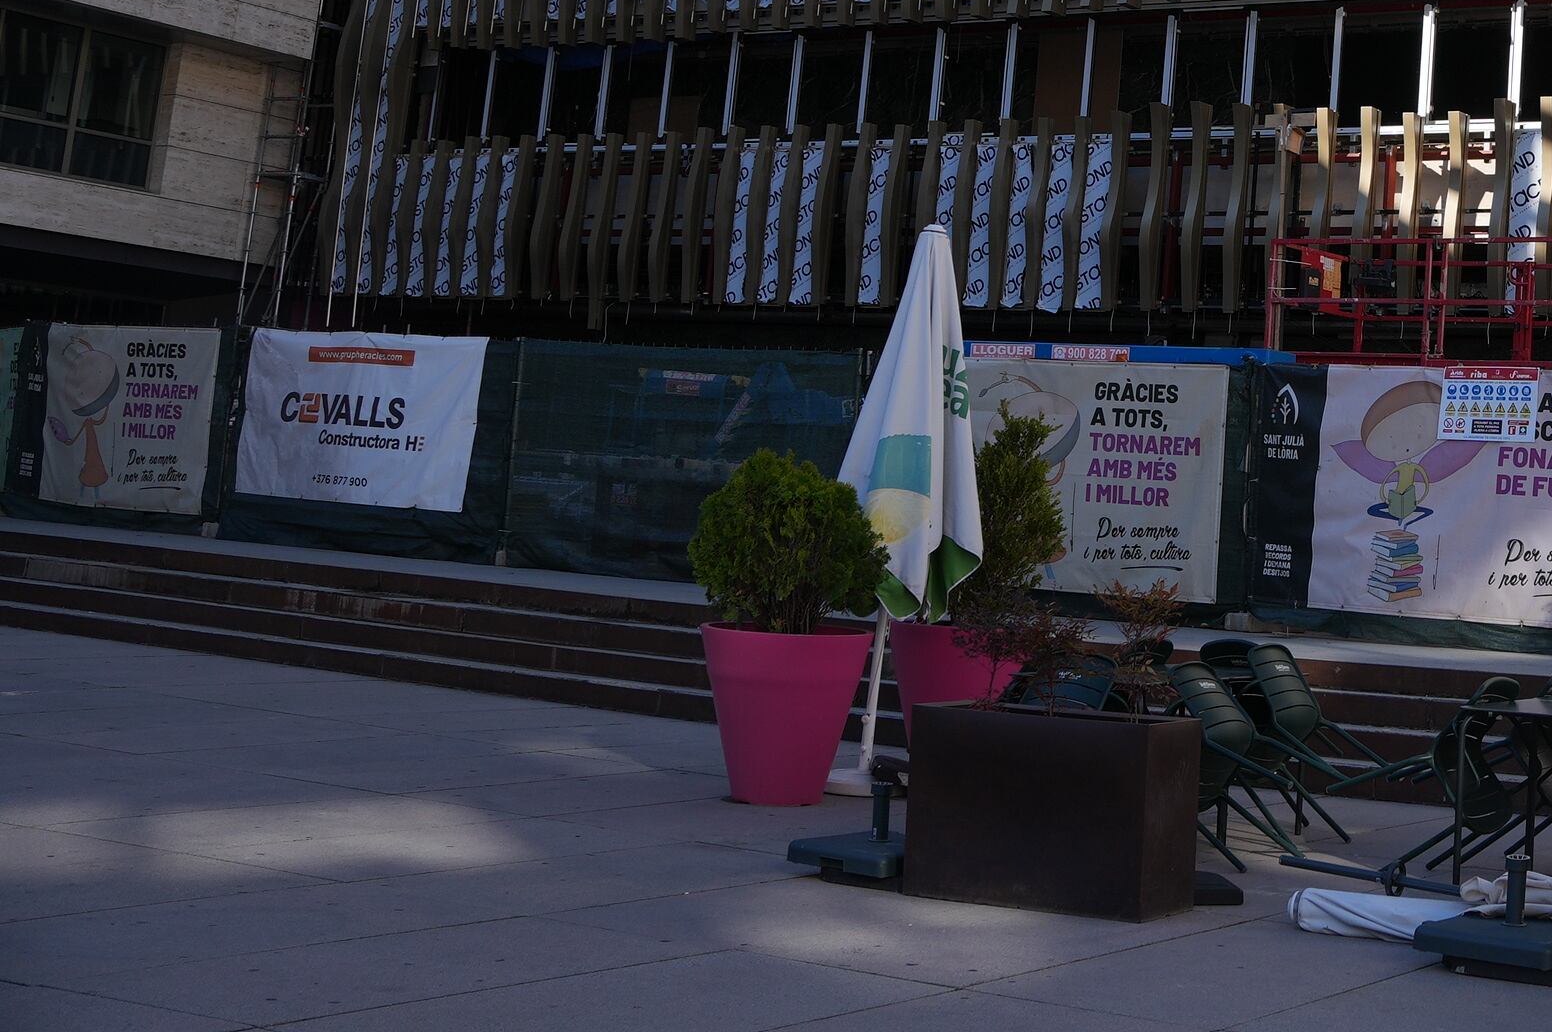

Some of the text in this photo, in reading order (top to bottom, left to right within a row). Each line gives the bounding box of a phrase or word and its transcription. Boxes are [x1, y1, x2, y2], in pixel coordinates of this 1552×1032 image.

[127, 340, 186, 358] GRÀCIES
[973, 345, 1032, 355] LLOGUER
[1068, 348, 1085, 358] 900
[1089, 348, 1106, 359] 828
[126, 363, 178, 380] A TOTS,
[1470, 369, 1488, 378] riba
[126, 383, 198, 400] TORNAREM
[1095, 379, 1179, 403] GRÀCIES
[123, 401, 183, 420] AMB MÉS
[1090, 408, 1168, 431] A TOTS,
[128, 424, 176, 440] MILLOR
[319, 430, 399, 449] Constructora
[1263, 433, 1305, 447] SANT JULIÀ
[1090, 433, 1200, 456] TORNAREM
[1267, 446, 1299, 460] DE LÒRIA
[1086, 457, 1177, 481] AMB MÉS
[312, 474, 368, 487] +376 877 900
[1495, 474, 1527, 497] DE
[1085, 484, 1170, 506] I MILLOR
[1131, 525, 1180, 541] sempre
[1092, 547, 1117, 562] per
[1150, 541, 1192, 561] cultura
[1265, 543, 1292, 552] REPASSA
[1505, 539, 1542, 567] Per
[1488, 571, 1495, 585] i
[1499, 573, 1528, 589] per
